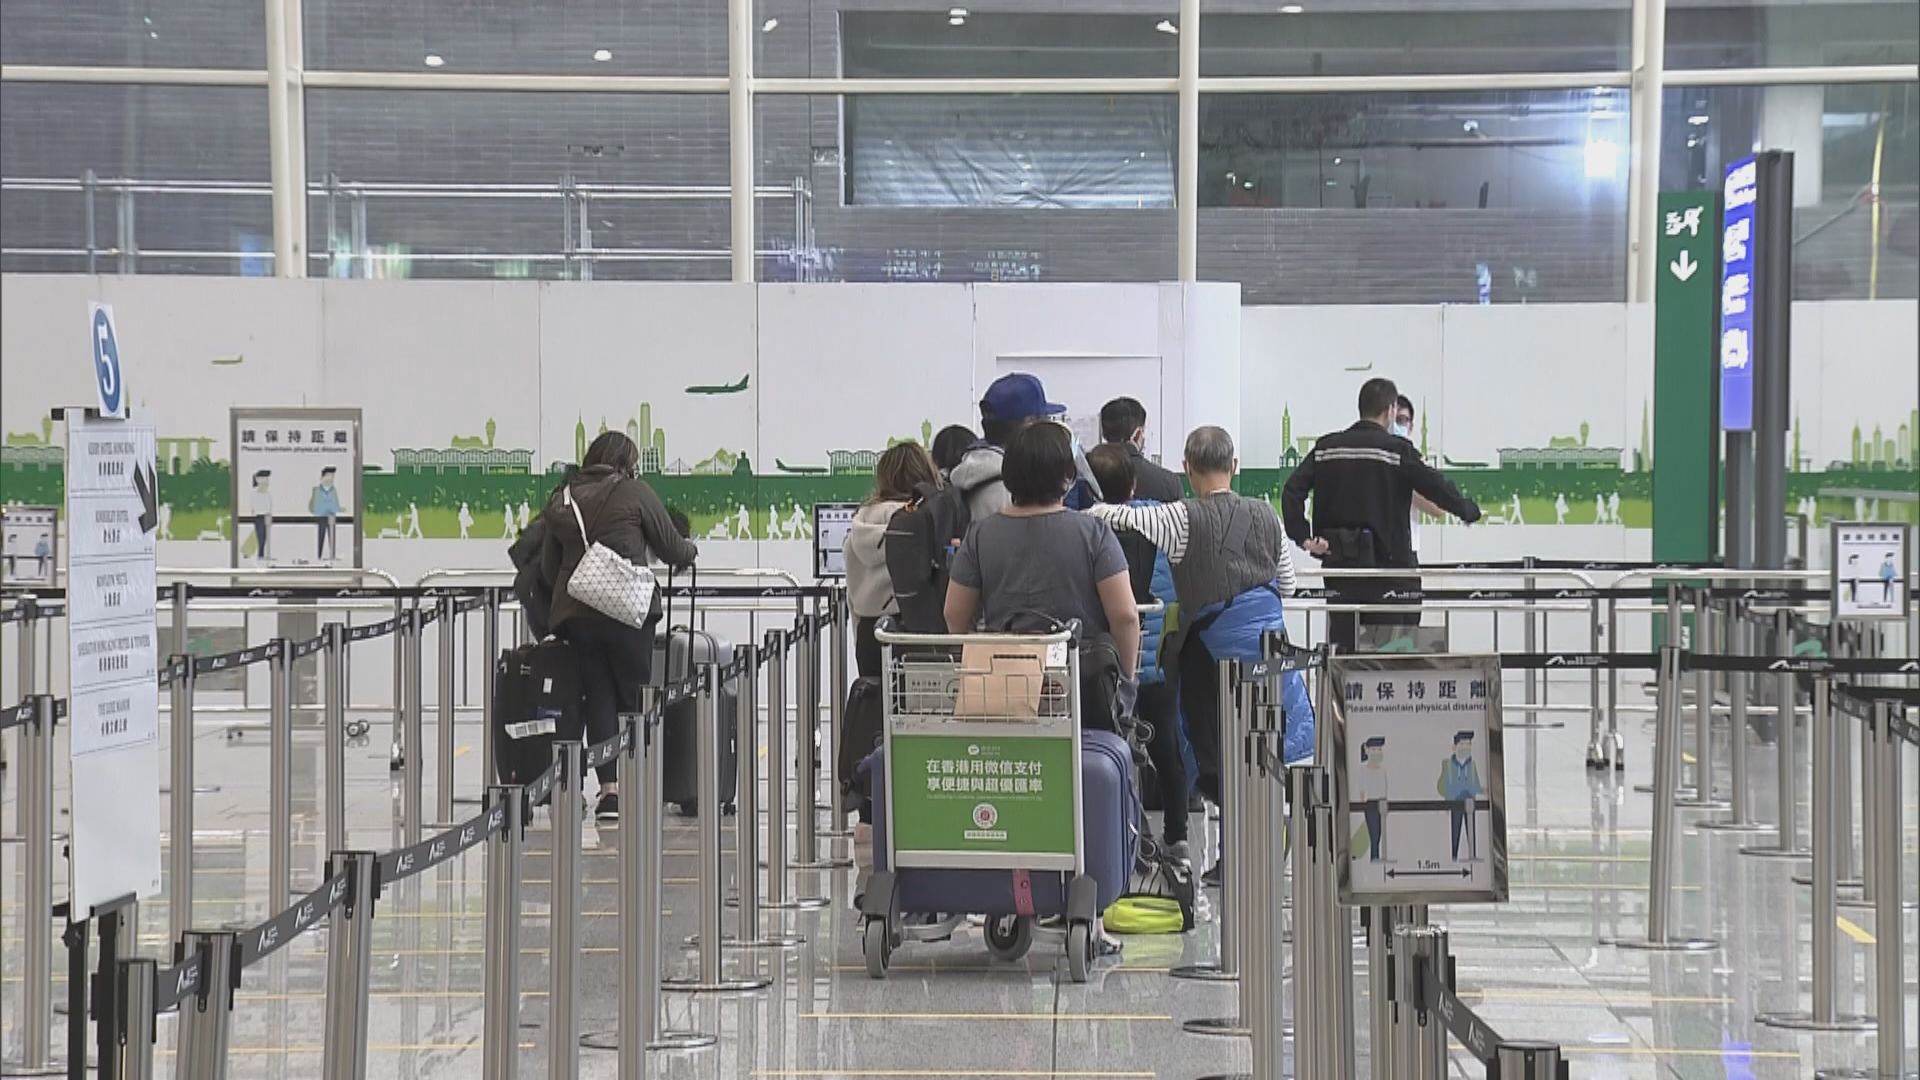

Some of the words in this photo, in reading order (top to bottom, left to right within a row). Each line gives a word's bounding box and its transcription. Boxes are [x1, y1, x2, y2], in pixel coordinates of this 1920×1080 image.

[97, 322, 115, 395] 5
[241, 430, 347, 444] 請保持距離
[1345, 680, 1487, 701] 請保持距離
[1346, 703, 1373, 713] Please
[1376, 704, 1413, 713] maintain
[1415, 702, 1451, 714] physical
[926, 759, 1043, 776] 在香港用微信支付
[1418, 859, 1440, 869] 1.5m
